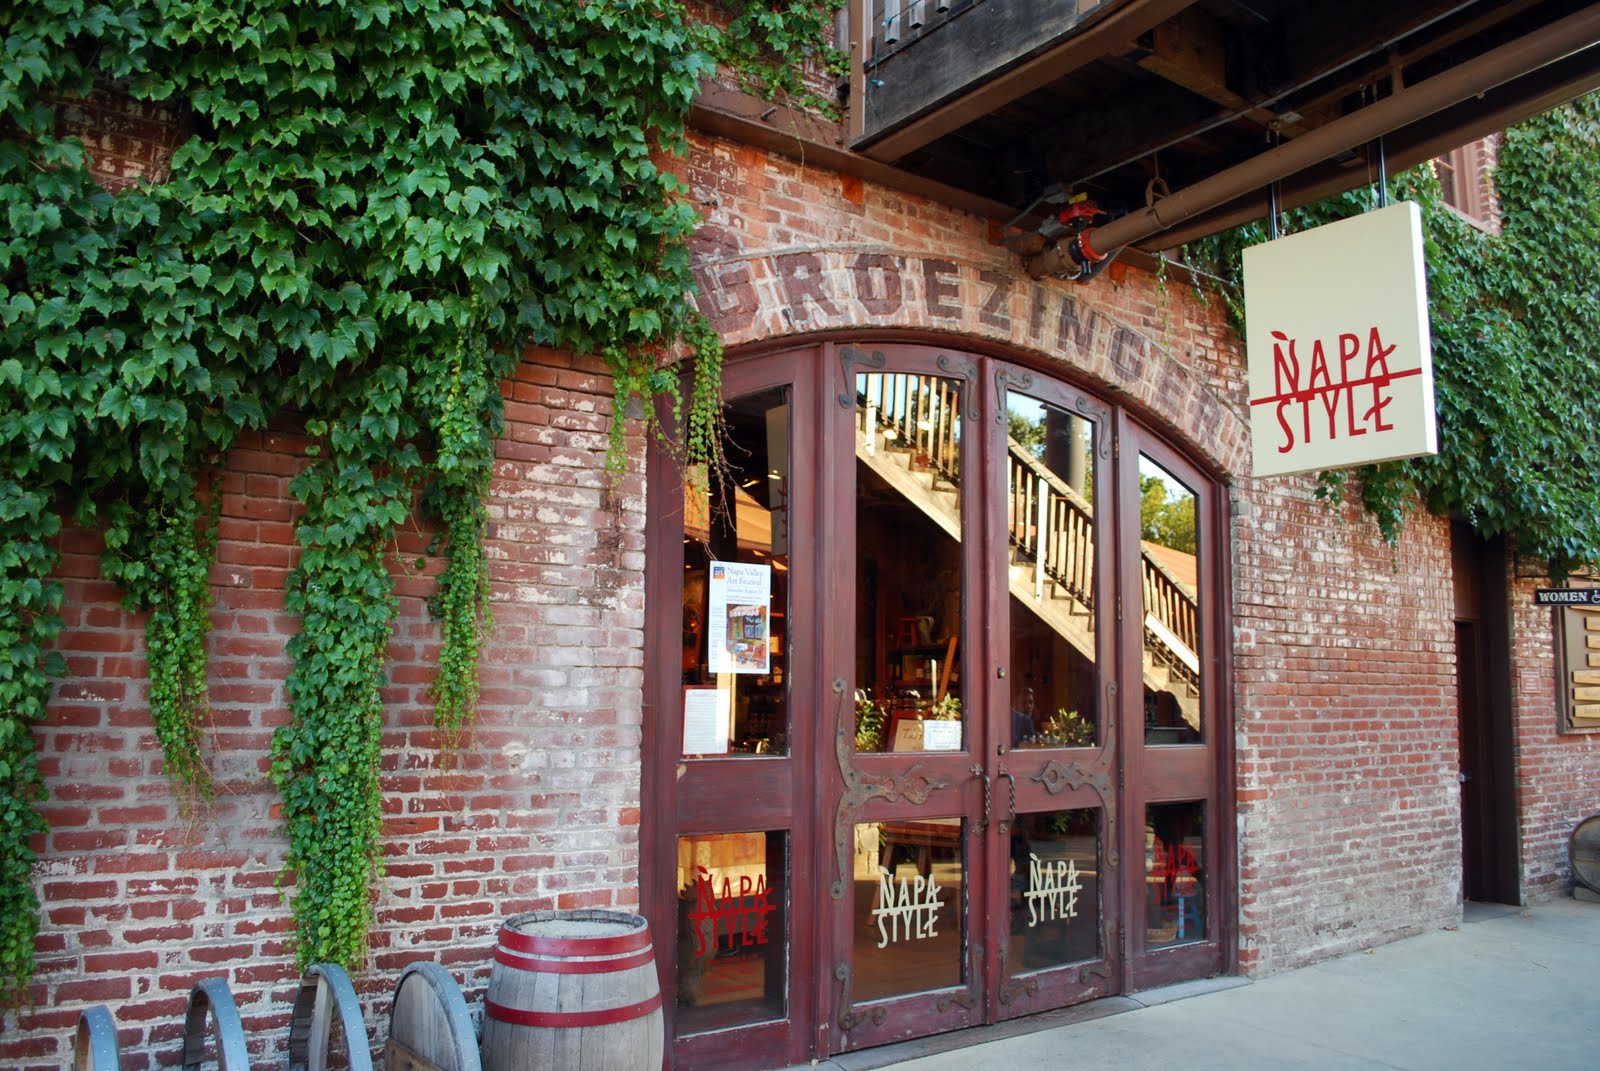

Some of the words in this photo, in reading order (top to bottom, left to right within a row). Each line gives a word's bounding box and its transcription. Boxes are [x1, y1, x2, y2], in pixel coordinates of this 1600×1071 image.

[1276, 379, 1394, 454] STYLE
[727, 566, 744, 577] Napa
[745, 567, 764, 577] Valley
[727, 576, 738, 584] Art
[1538, 592, 1588, 602] WOMEN
[877, 905, 939, 949] STYLE
[1028, 888, 1078, 928] STYLE
[693, 907, 769, 957] STYLE
